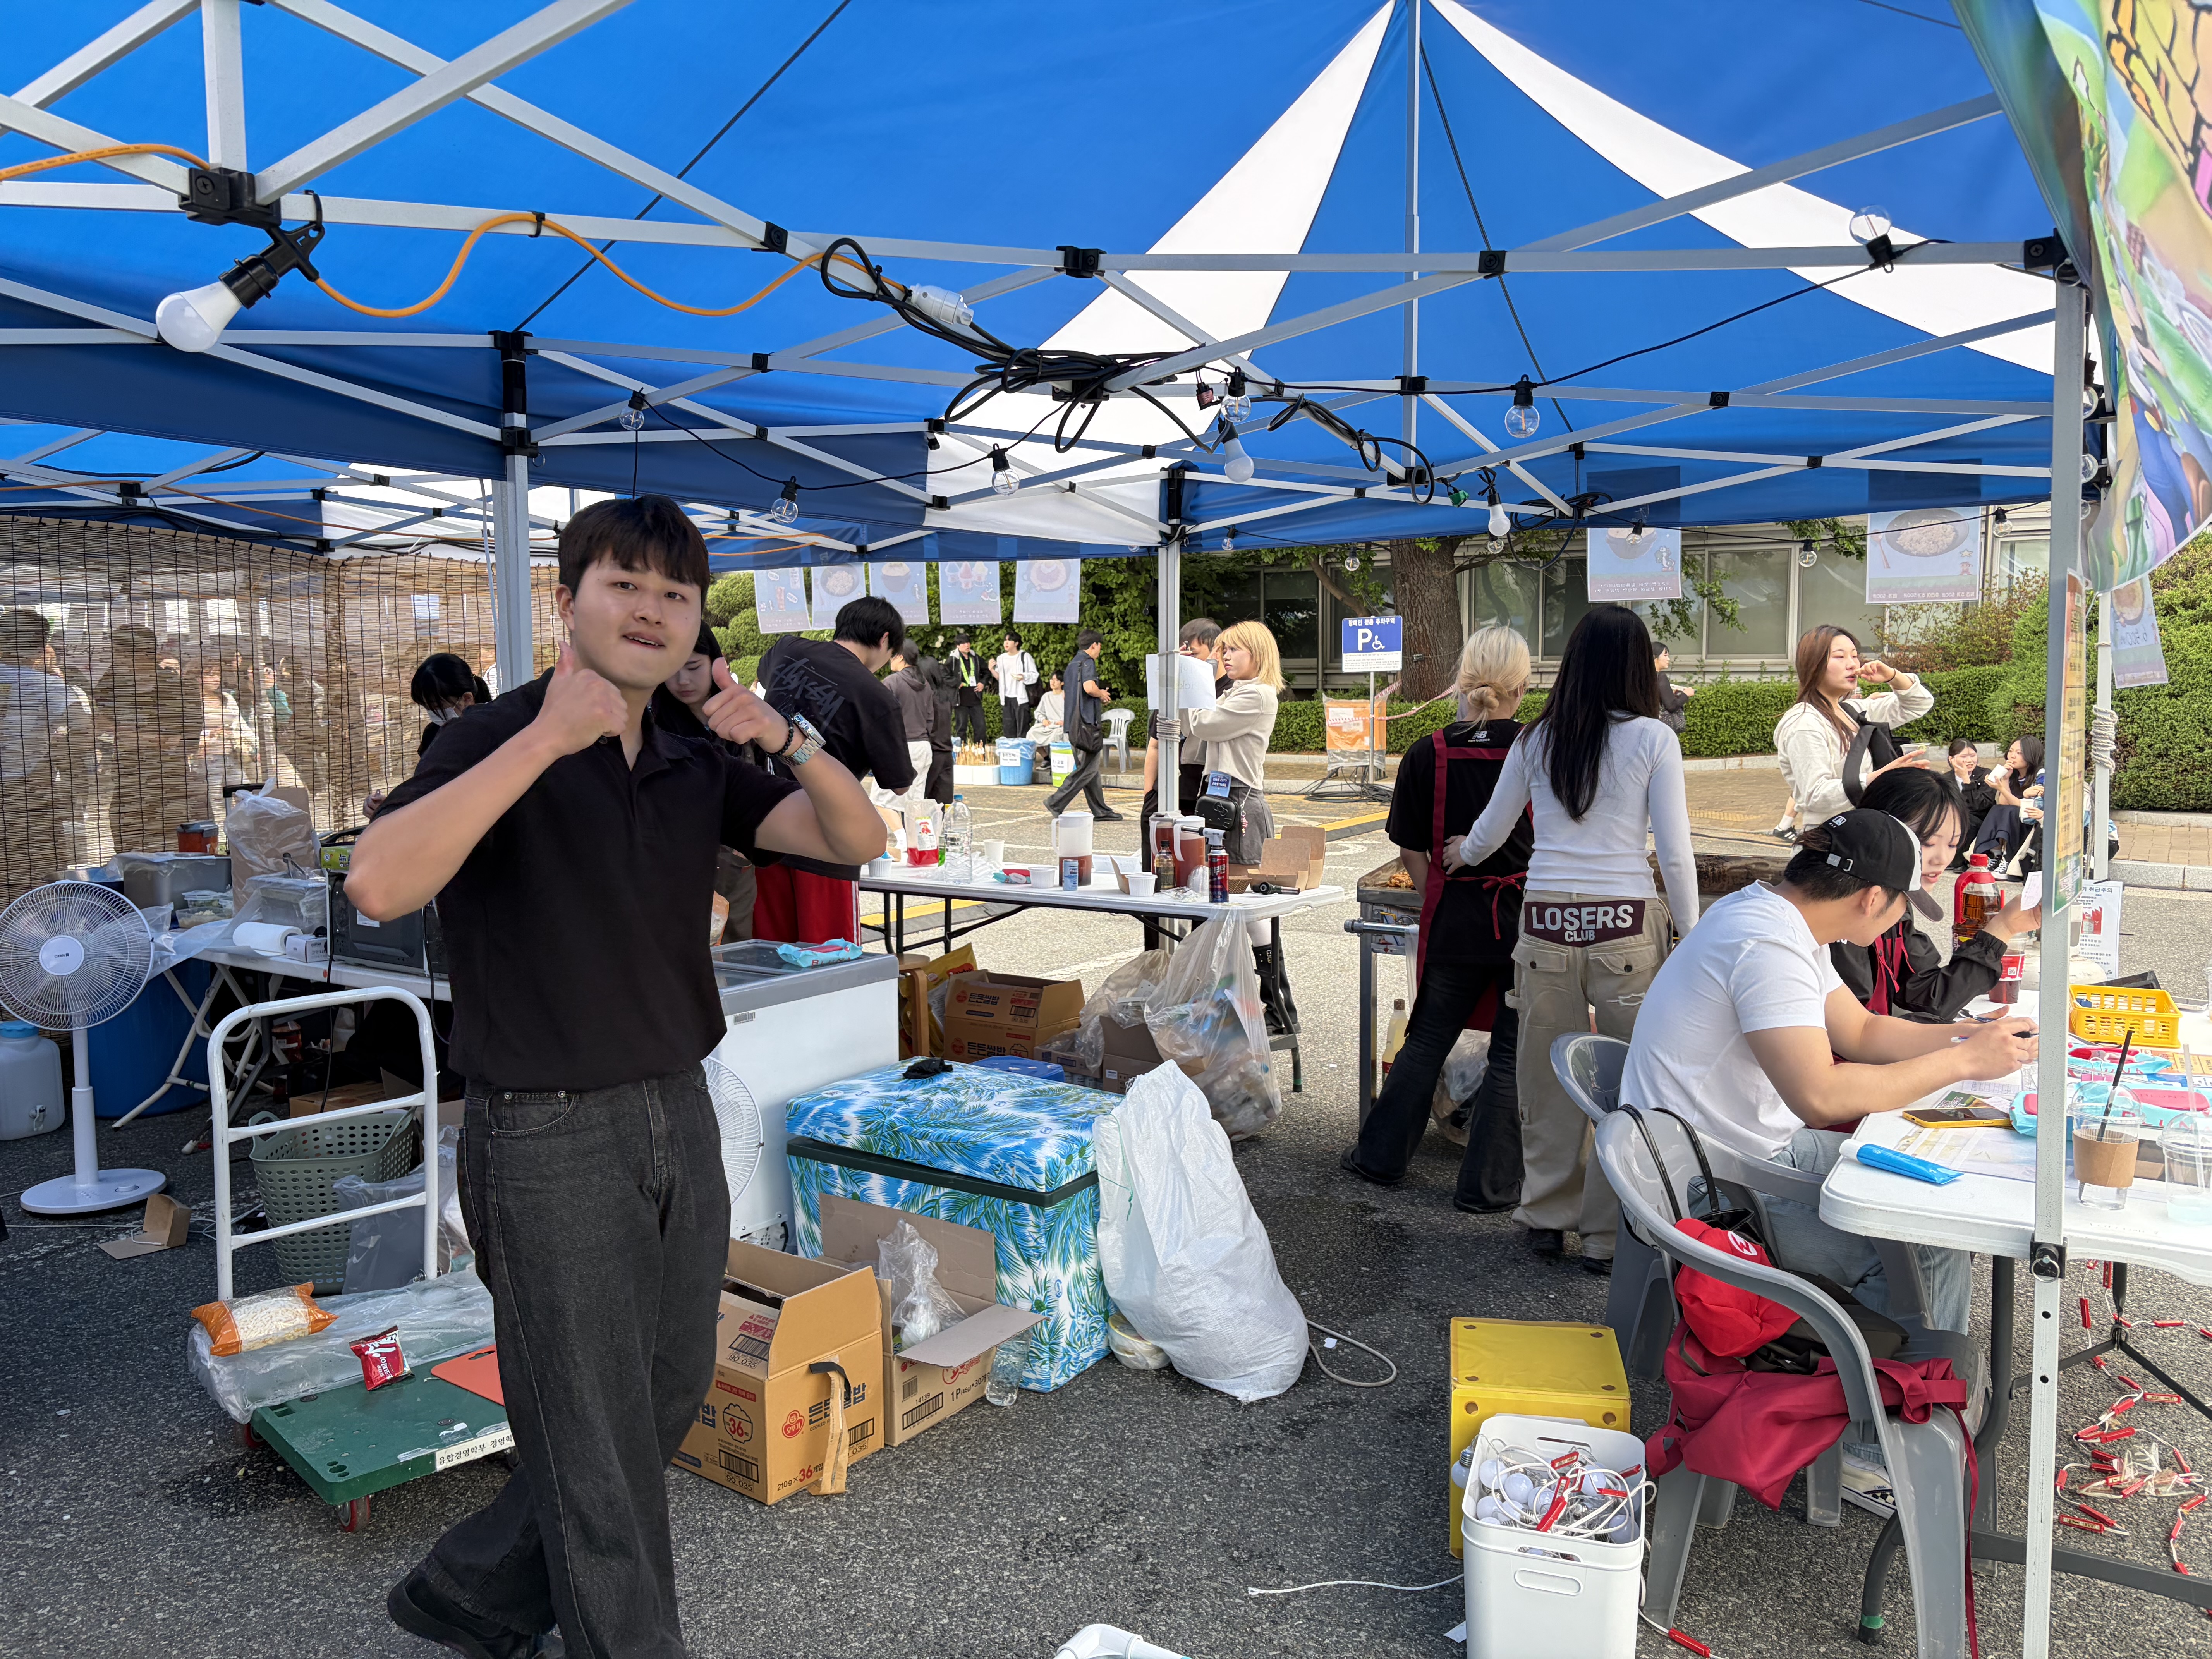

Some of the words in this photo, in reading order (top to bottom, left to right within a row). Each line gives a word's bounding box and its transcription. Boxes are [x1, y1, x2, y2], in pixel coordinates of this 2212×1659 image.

[1358, 628, 1372, 651] P
[1532, 905, 1634, 931] LOSERS
[1565, 930, 1595, 942] CLUB
[740, 1358, 756, 1368] 035
[915, 1392, 931, 1405] 14139
[729, 1417, 744, 1437] 36
[810, 1421, 826, 1431] COOKED
[852, 1443, 867, 1455] 035
[726, 1475, 736, 1484] 90
[738, 1480, 752, 1491] 035
[777, 1479, 793, 1491] 210g
